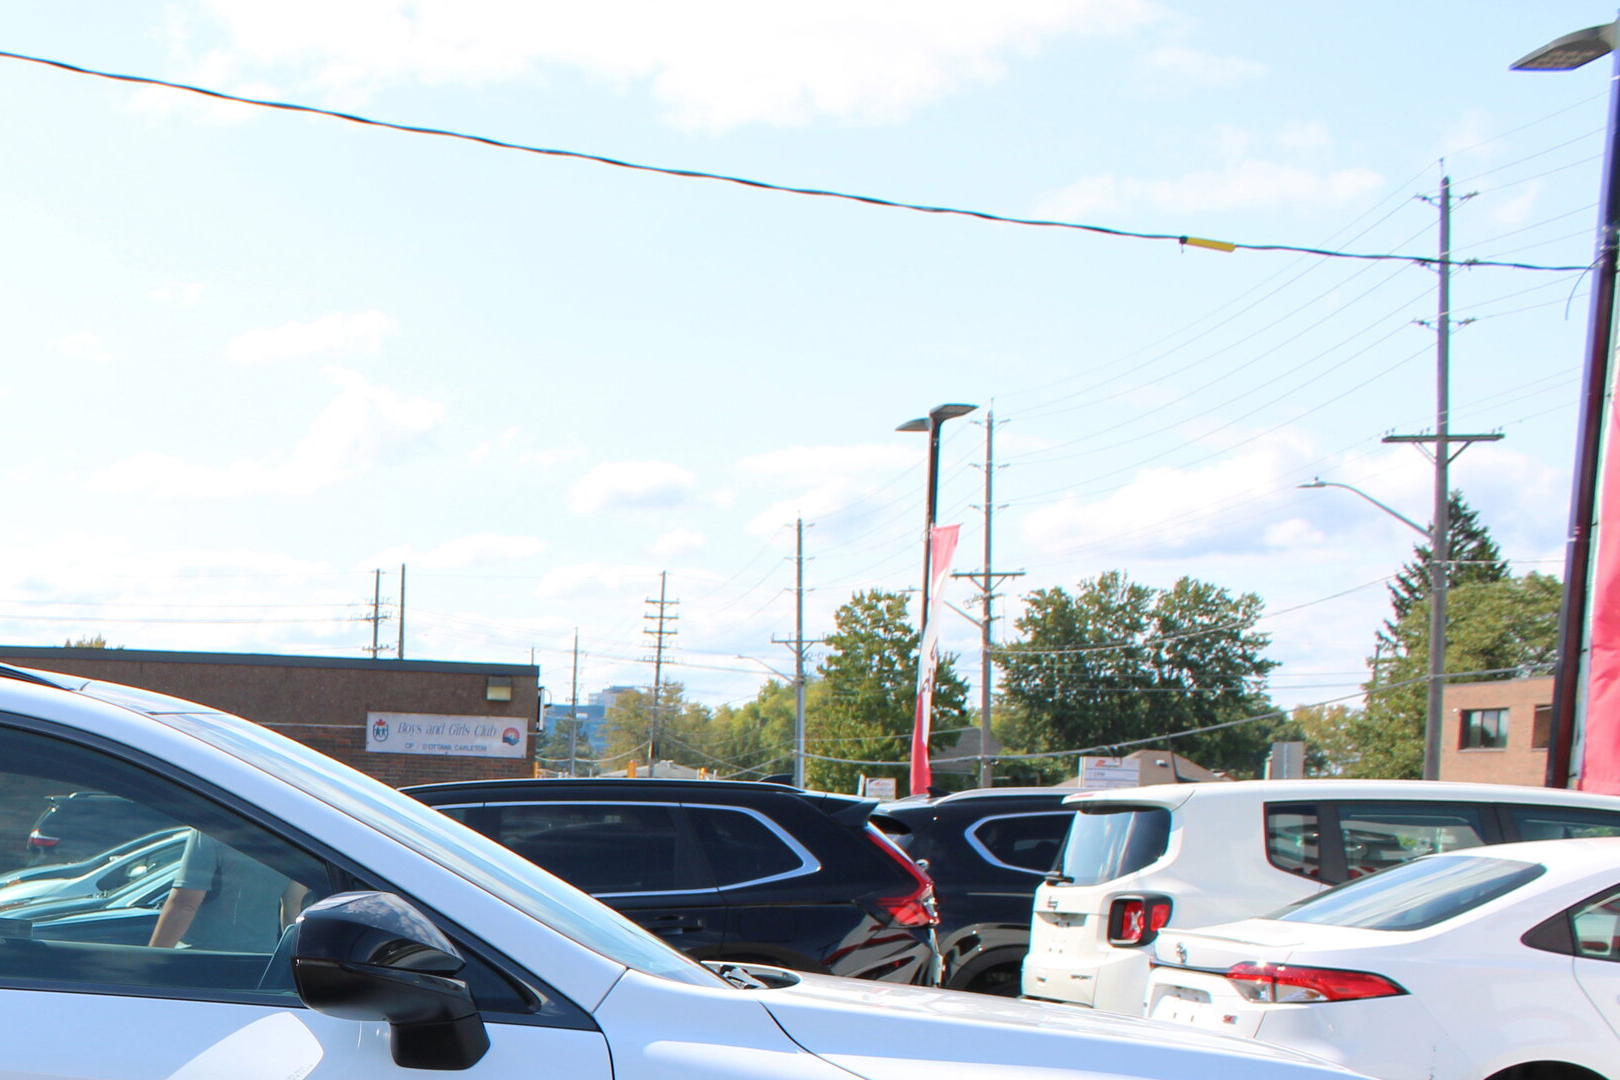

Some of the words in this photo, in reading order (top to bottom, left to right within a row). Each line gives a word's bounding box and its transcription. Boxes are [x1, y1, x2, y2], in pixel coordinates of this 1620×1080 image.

[397, 721, 422, 736] Boys
[426, 723, 446, 736] and
[448, 723, 471, 737] Girls
[474, 724, 498, 737] Club
